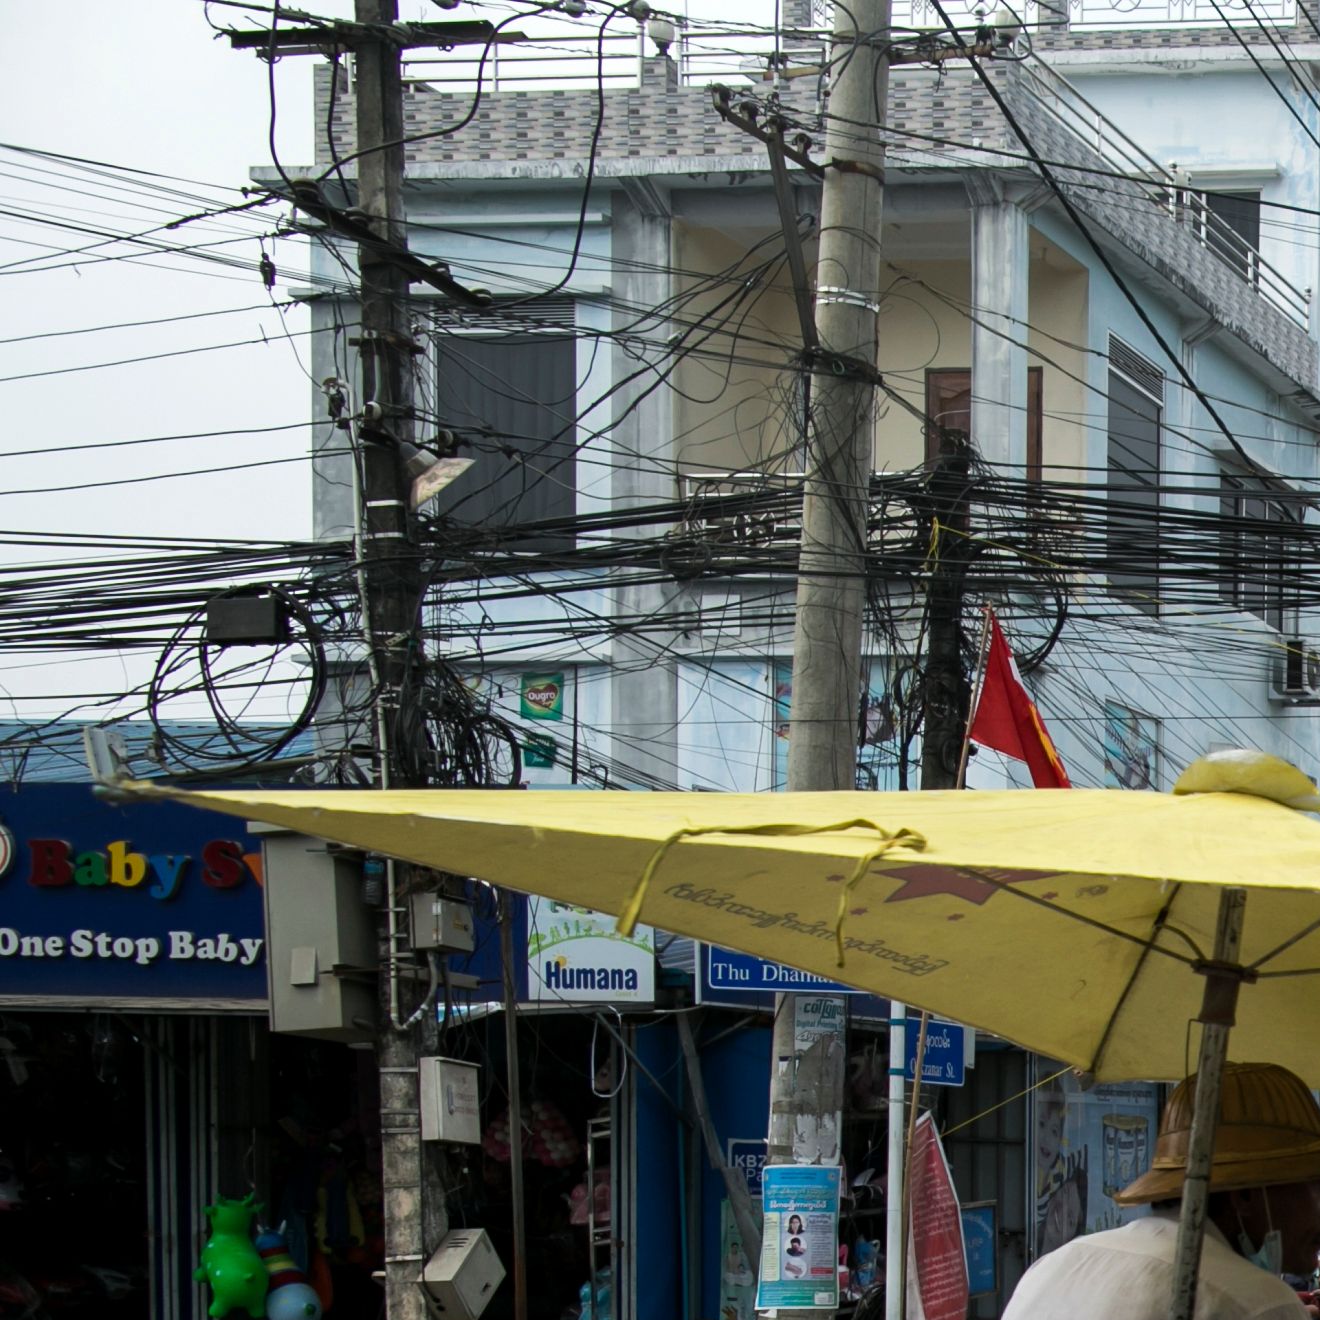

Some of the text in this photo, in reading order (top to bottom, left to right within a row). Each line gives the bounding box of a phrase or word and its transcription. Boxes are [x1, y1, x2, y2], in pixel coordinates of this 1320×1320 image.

[28, 839, 192, 899] Baby
[0, 927, 264, 966] One Stop Baby
[545, 960, 638, 991] Humana
[713, 962, 750, 980] Thu
[734, 1154, 767, 1168] KBZ
[746, 1168, 762, 1183] Pa
